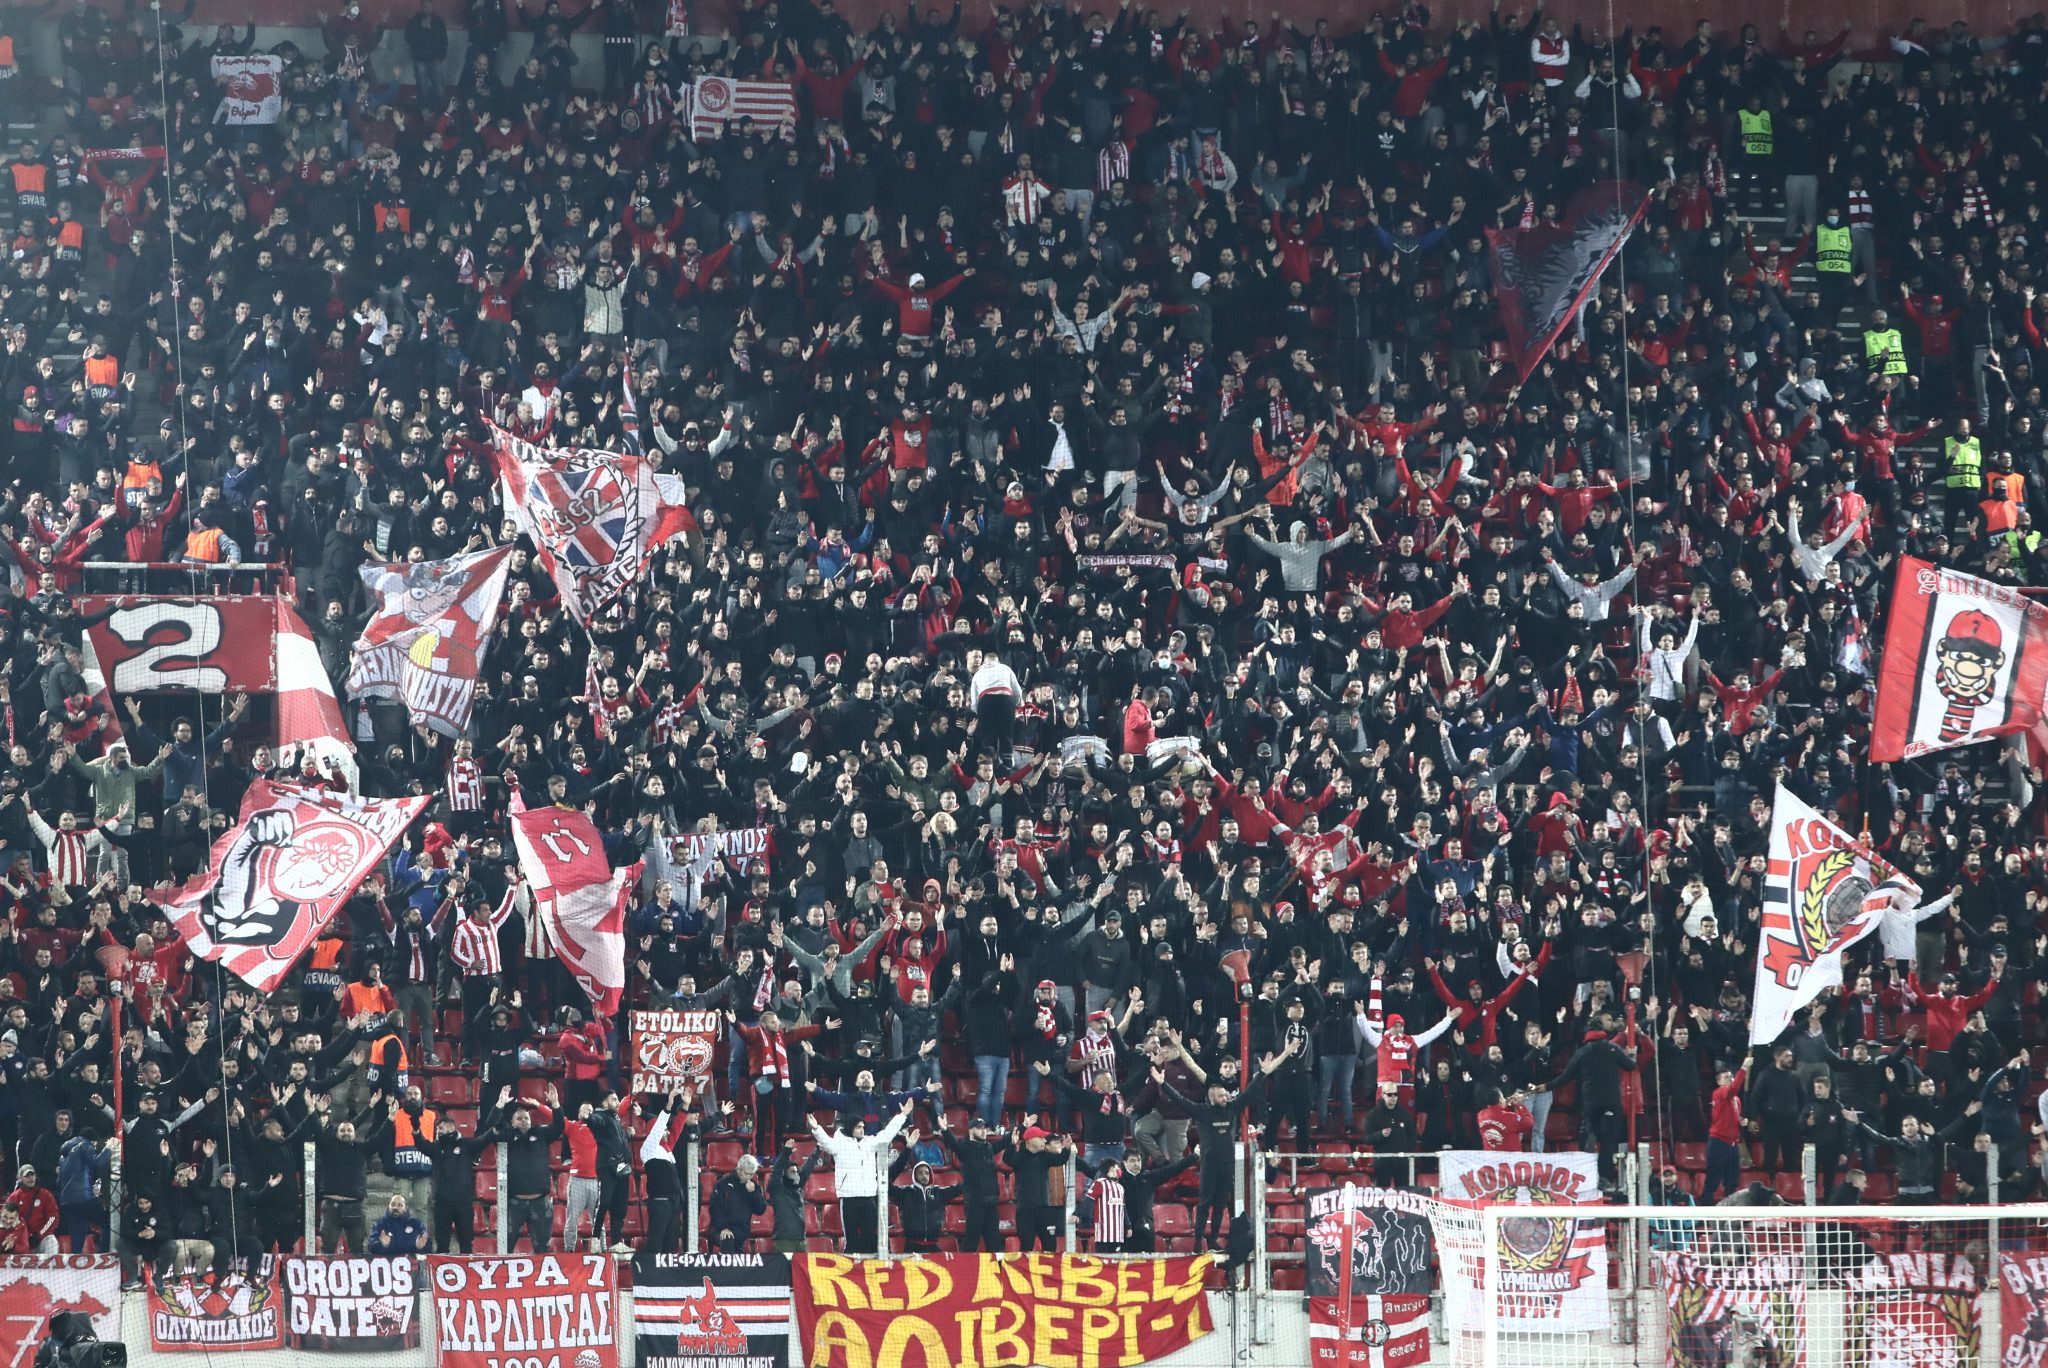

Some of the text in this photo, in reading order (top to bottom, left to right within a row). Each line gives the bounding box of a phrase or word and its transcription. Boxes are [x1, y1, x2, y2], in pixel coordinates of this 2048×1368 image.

[1751, 143, 1768, 152] 052
[1818, 251, 1850, 260] STEWAR
[1828, 262, 1845, 270] 054
[109, 602, 227, 693] 2
[304, 972, 341, 986] STEWARD
[635, 1012, 717, 1033] ETOLIKO
[632, 1073, 710, 1095] GATE 7
[394, 1150, 433, 1165] STEWAR
[1459, 1161, 1587, 1200] ΚΟΛΩΝΟΣ
[436, 1255, 606, 1293] ΘΥΡΑ 7
[655, 1252, 765, 1268] ΚΕΦΑΛΟΝΙΑ
[286, 1257, 413, 1297] OROPOS
[807, 1251, 1216, 1311] RED REBELS
[155, 1310, 277, 1341] ΟΛΥΜΠΙΑΚΟΣ
[290, 1296, 415, 1338] GATE 7
[435, 1290, 614, 1352] ΚΑΡΔΙΤΣΑΣ
[5, 1315, 46, 1368] 7
